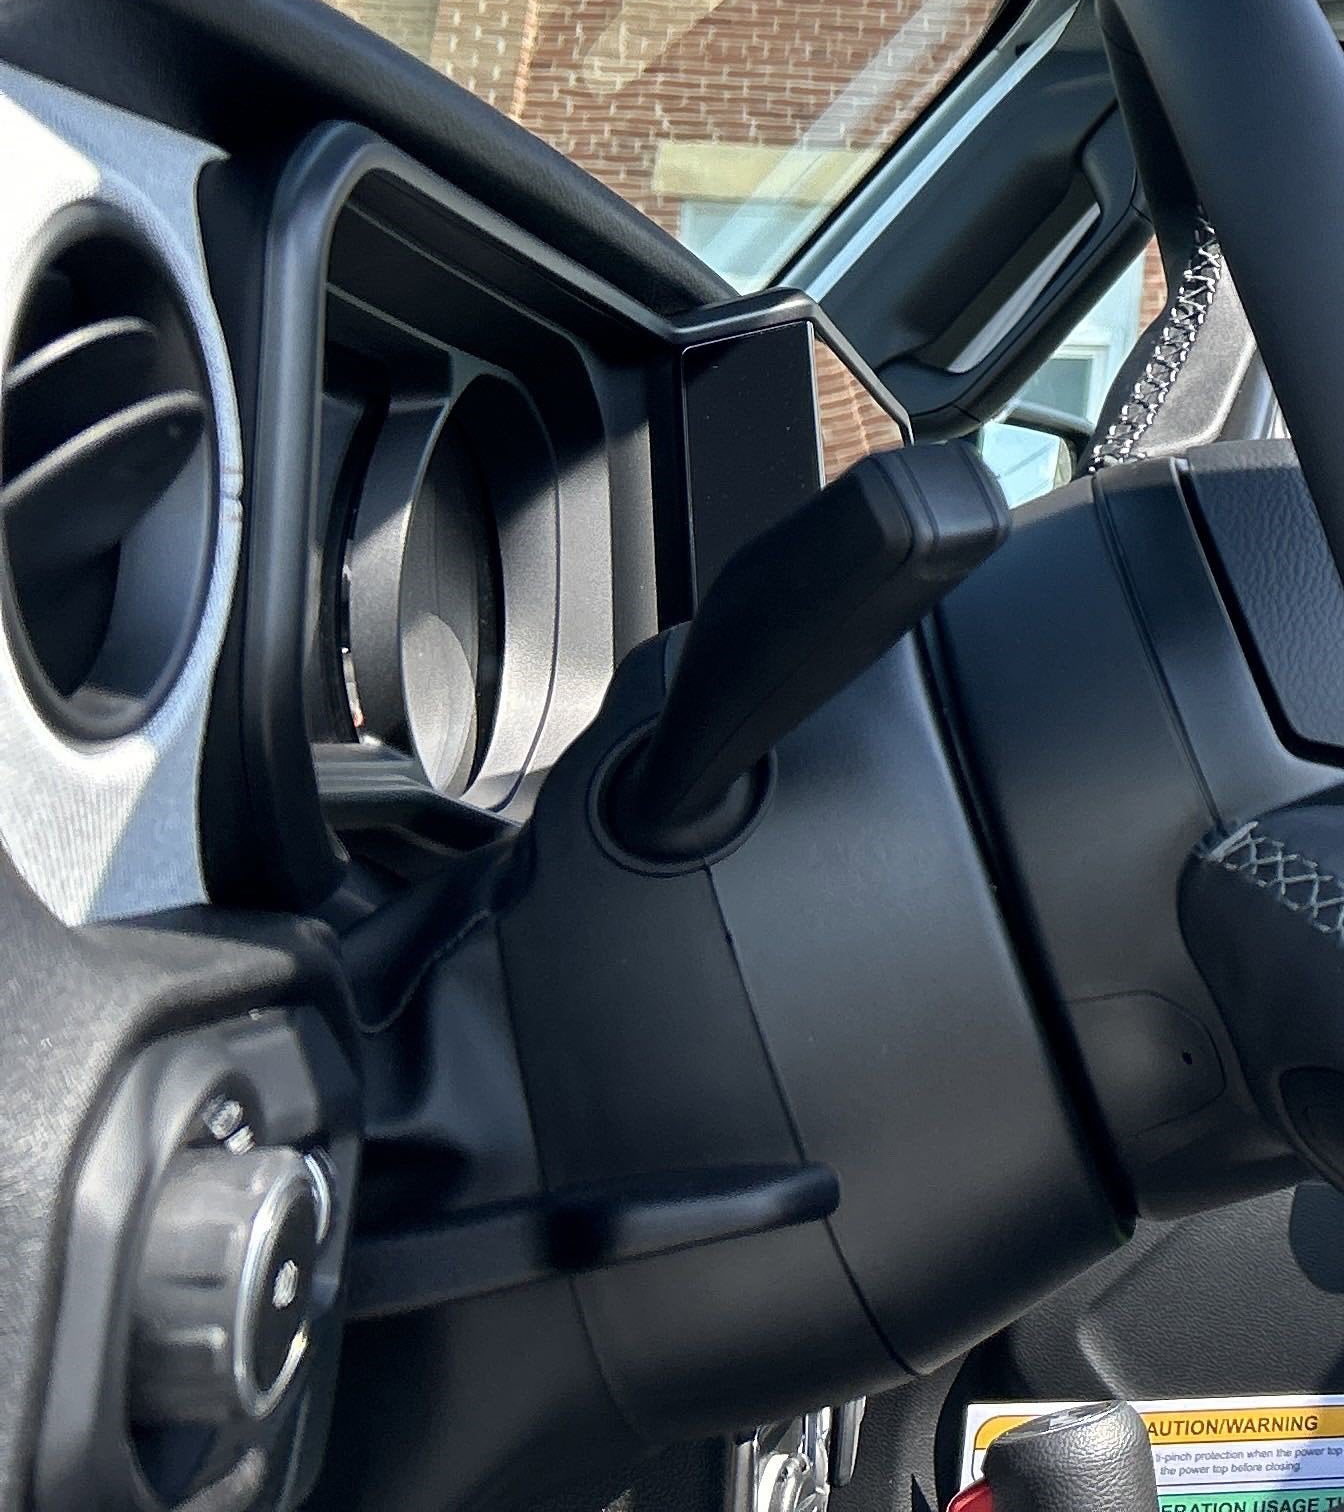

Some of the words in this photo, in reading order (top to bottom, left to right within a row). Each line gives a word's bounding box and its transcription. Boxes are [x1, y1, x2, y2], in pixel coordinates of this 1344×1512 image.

[1148, 1415, 1318, 1436] AUTION/WARNING
[1155, 1452, 1192, 1463] ti-pinch
[1195, 1449, 1244, 1463] protection
[1247, 1450, 1273, 1459] when
[1276, 1448, 1292, 1457] the
[1295, 1448, 1324, 1459] power
[1327, 1447, 1342, 1457] top
[1160, 1465, 1176, 1476] the
[1179, 1465, 1209, 1477] power
[1212, 1464, 1229, 1475] top
[1231, 1462, 1262, 1473] before
[1161, 1501, 1247, 1512] ERATION
[1253, 1498, 1320, 1512] USAGE
